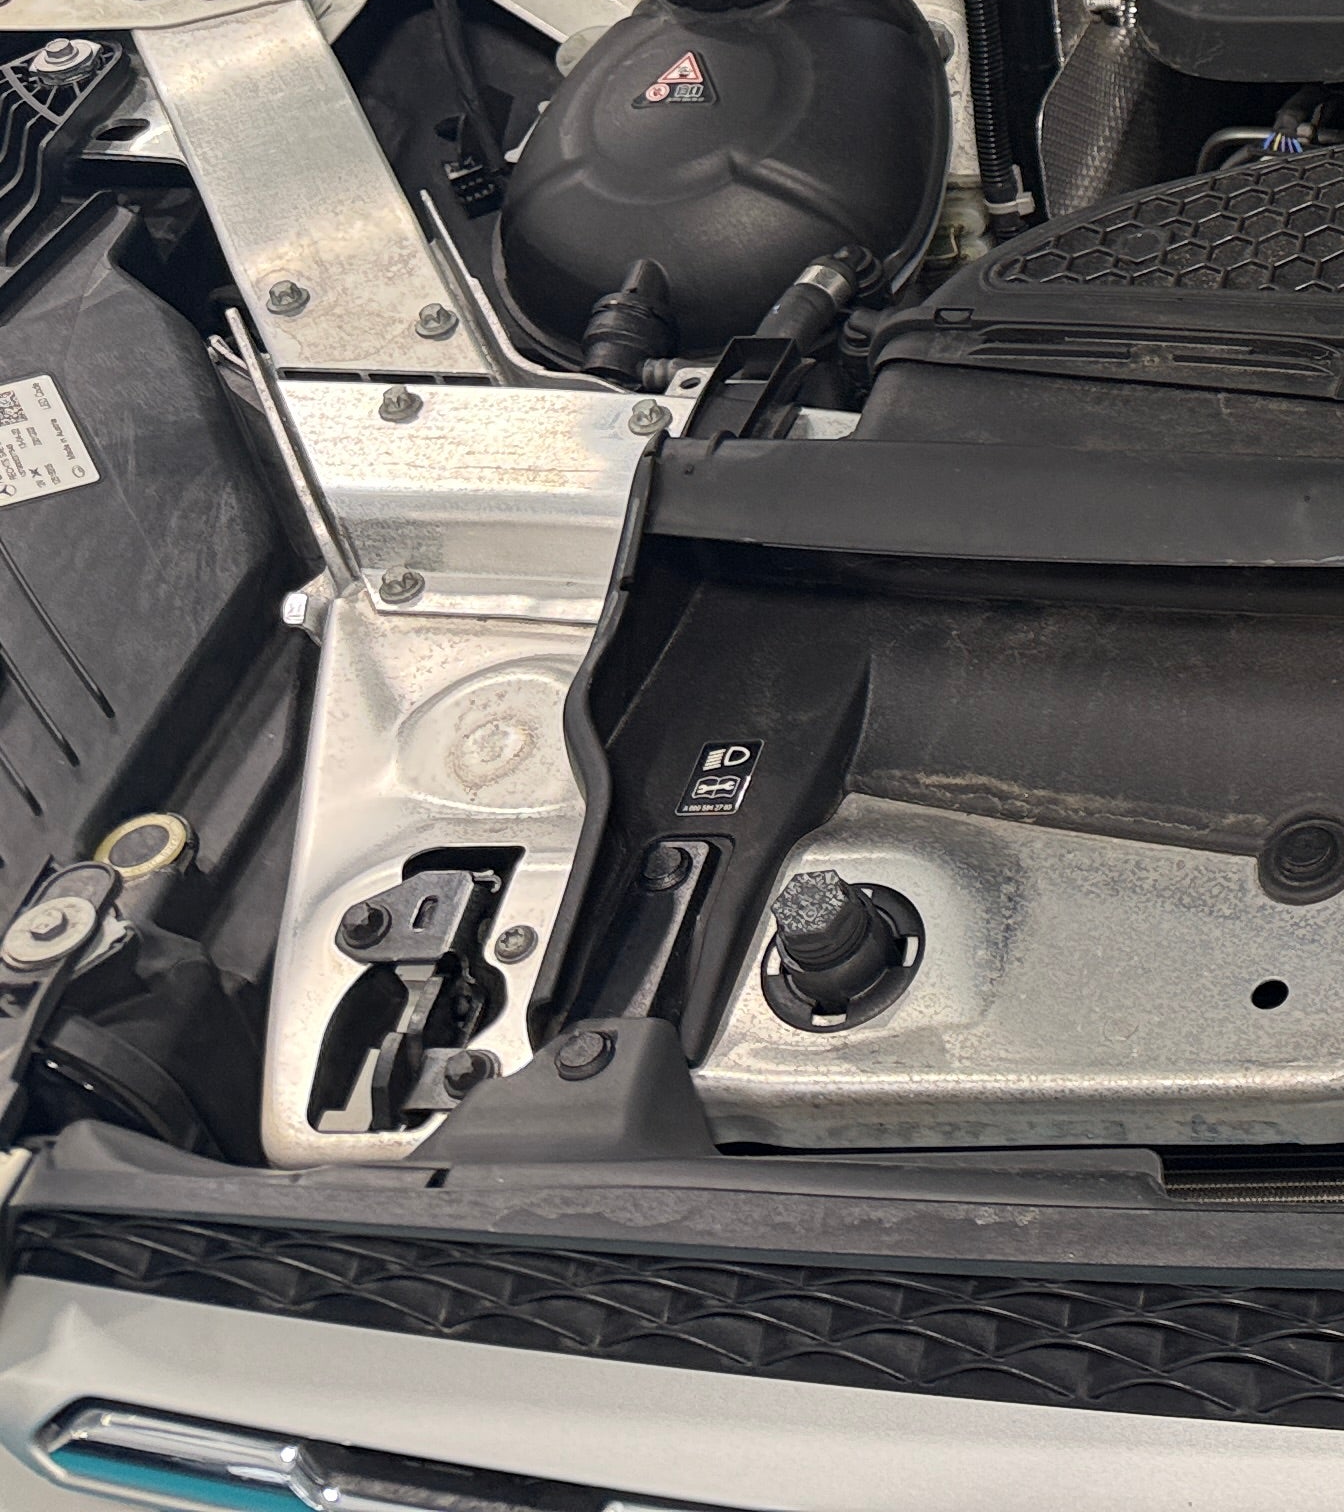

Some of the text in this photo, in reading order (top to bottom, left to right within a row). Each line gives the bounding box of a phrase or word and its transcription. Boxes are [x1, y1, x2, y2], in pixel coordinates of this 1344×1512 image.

[33, 382, 44, 397] Code
[51, 418, 64, 437] Austria
[63, 444, 76, 460] Made
